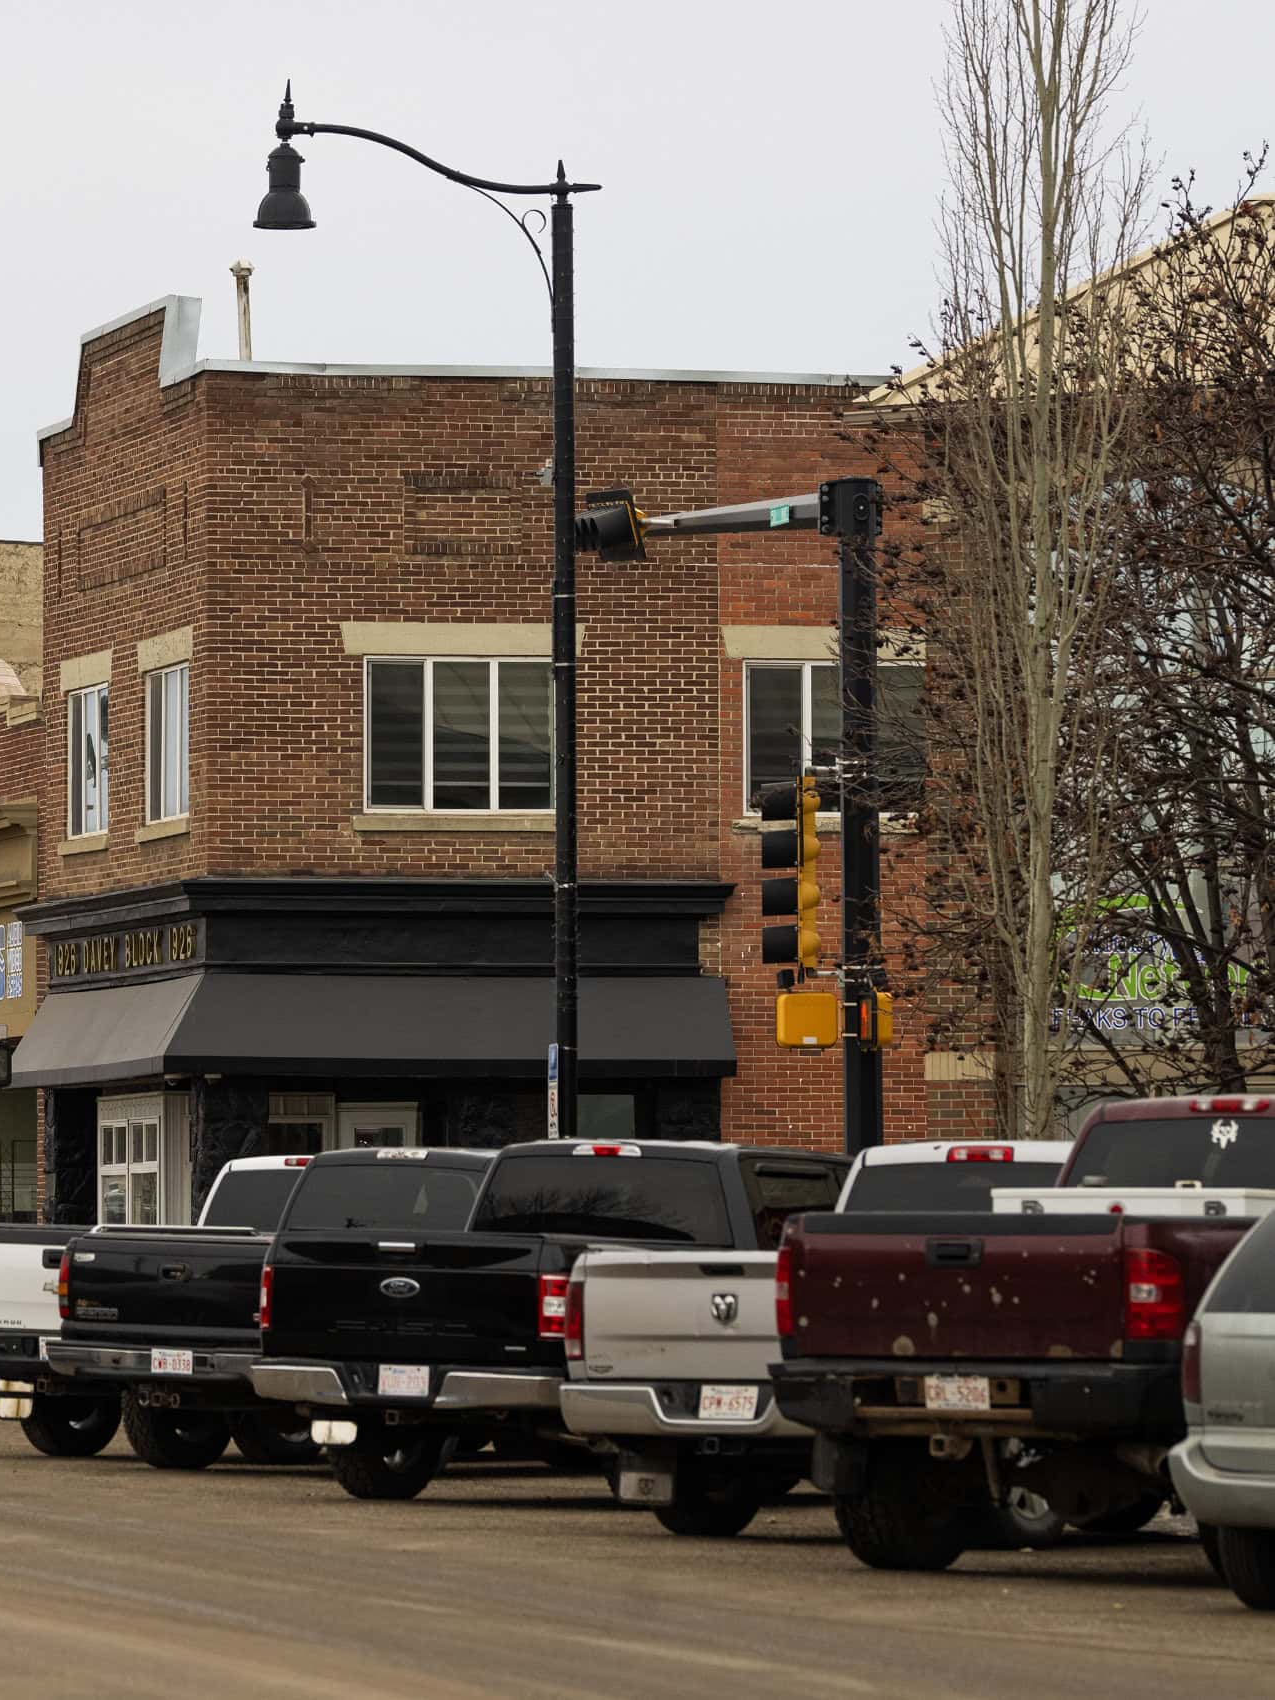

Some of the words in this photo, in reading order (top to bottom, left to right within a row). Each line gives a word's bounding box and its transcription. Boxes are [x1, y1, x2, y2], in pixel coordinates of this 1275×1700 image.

[54, 943, 77, 977] 1926
[83, 935, 117, 973] DAVEY
[125, 930, 160, 968] BLOCK
[168, 924, 194, 961] 1926
